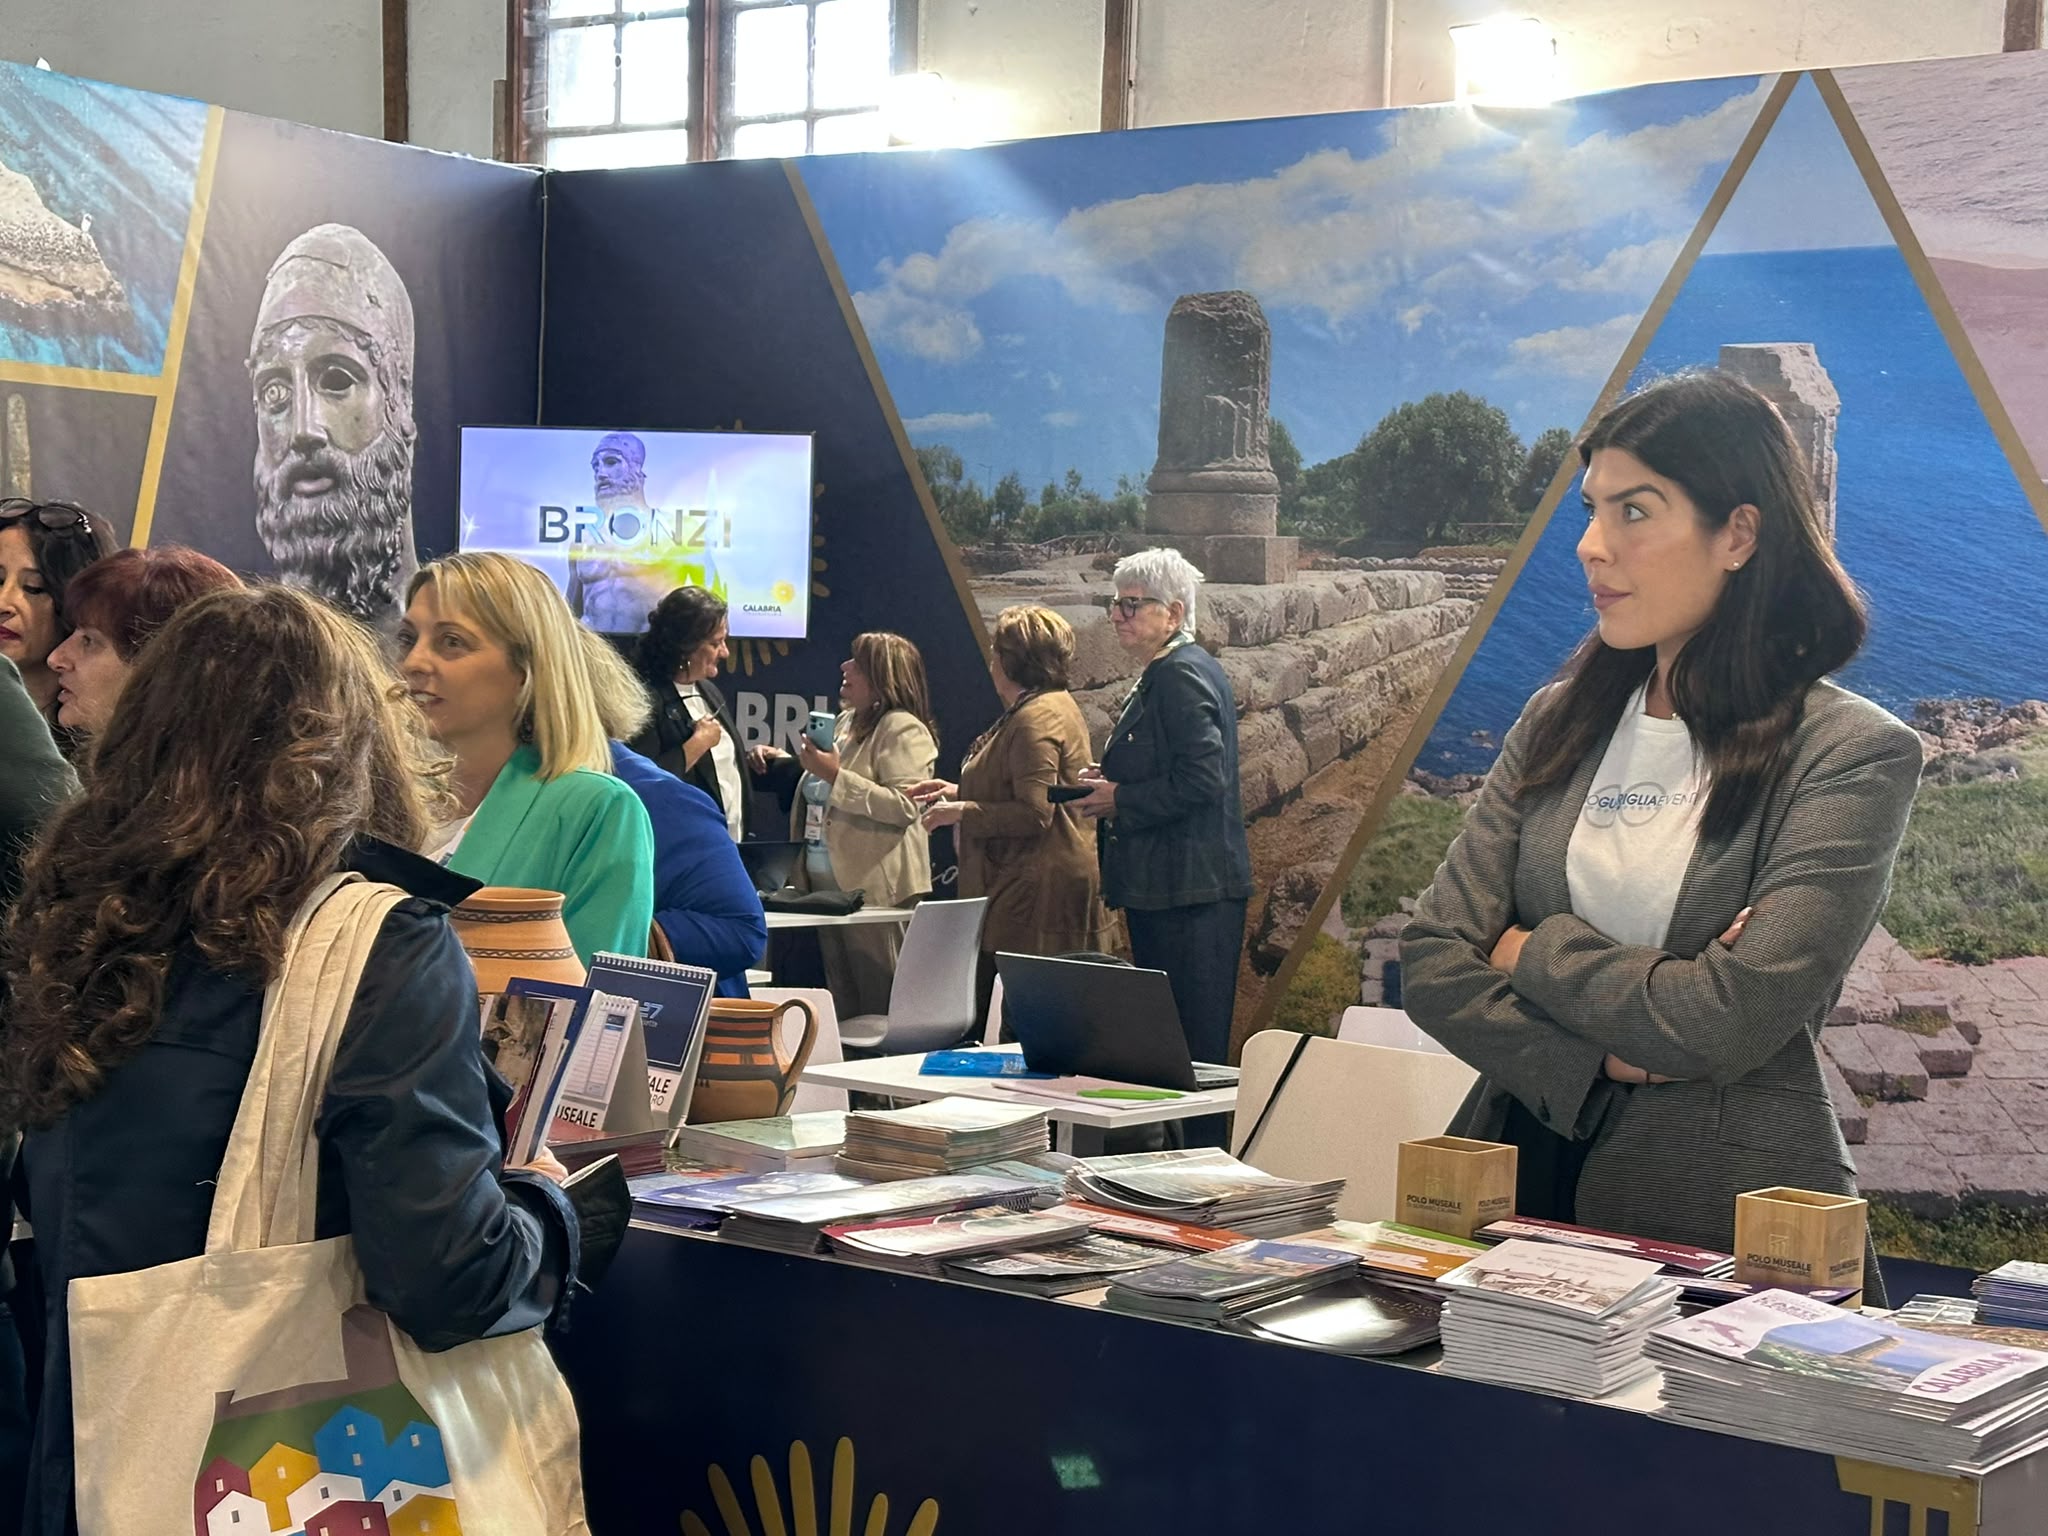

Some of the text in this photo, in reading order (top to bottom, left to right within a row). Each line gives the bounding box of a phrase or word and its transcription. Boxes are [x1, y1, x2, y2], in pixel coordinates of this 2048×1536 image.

[539, 505, 731, 549] BRONZI
[742, 603, 782, 613] CALABRIA
[1406, 1194, 1428, 1205] POLO
[1746, 1252, 1812, 1272] POLO MUSEALE
[1911, 1358, 2013, 1394] CALABRIA
